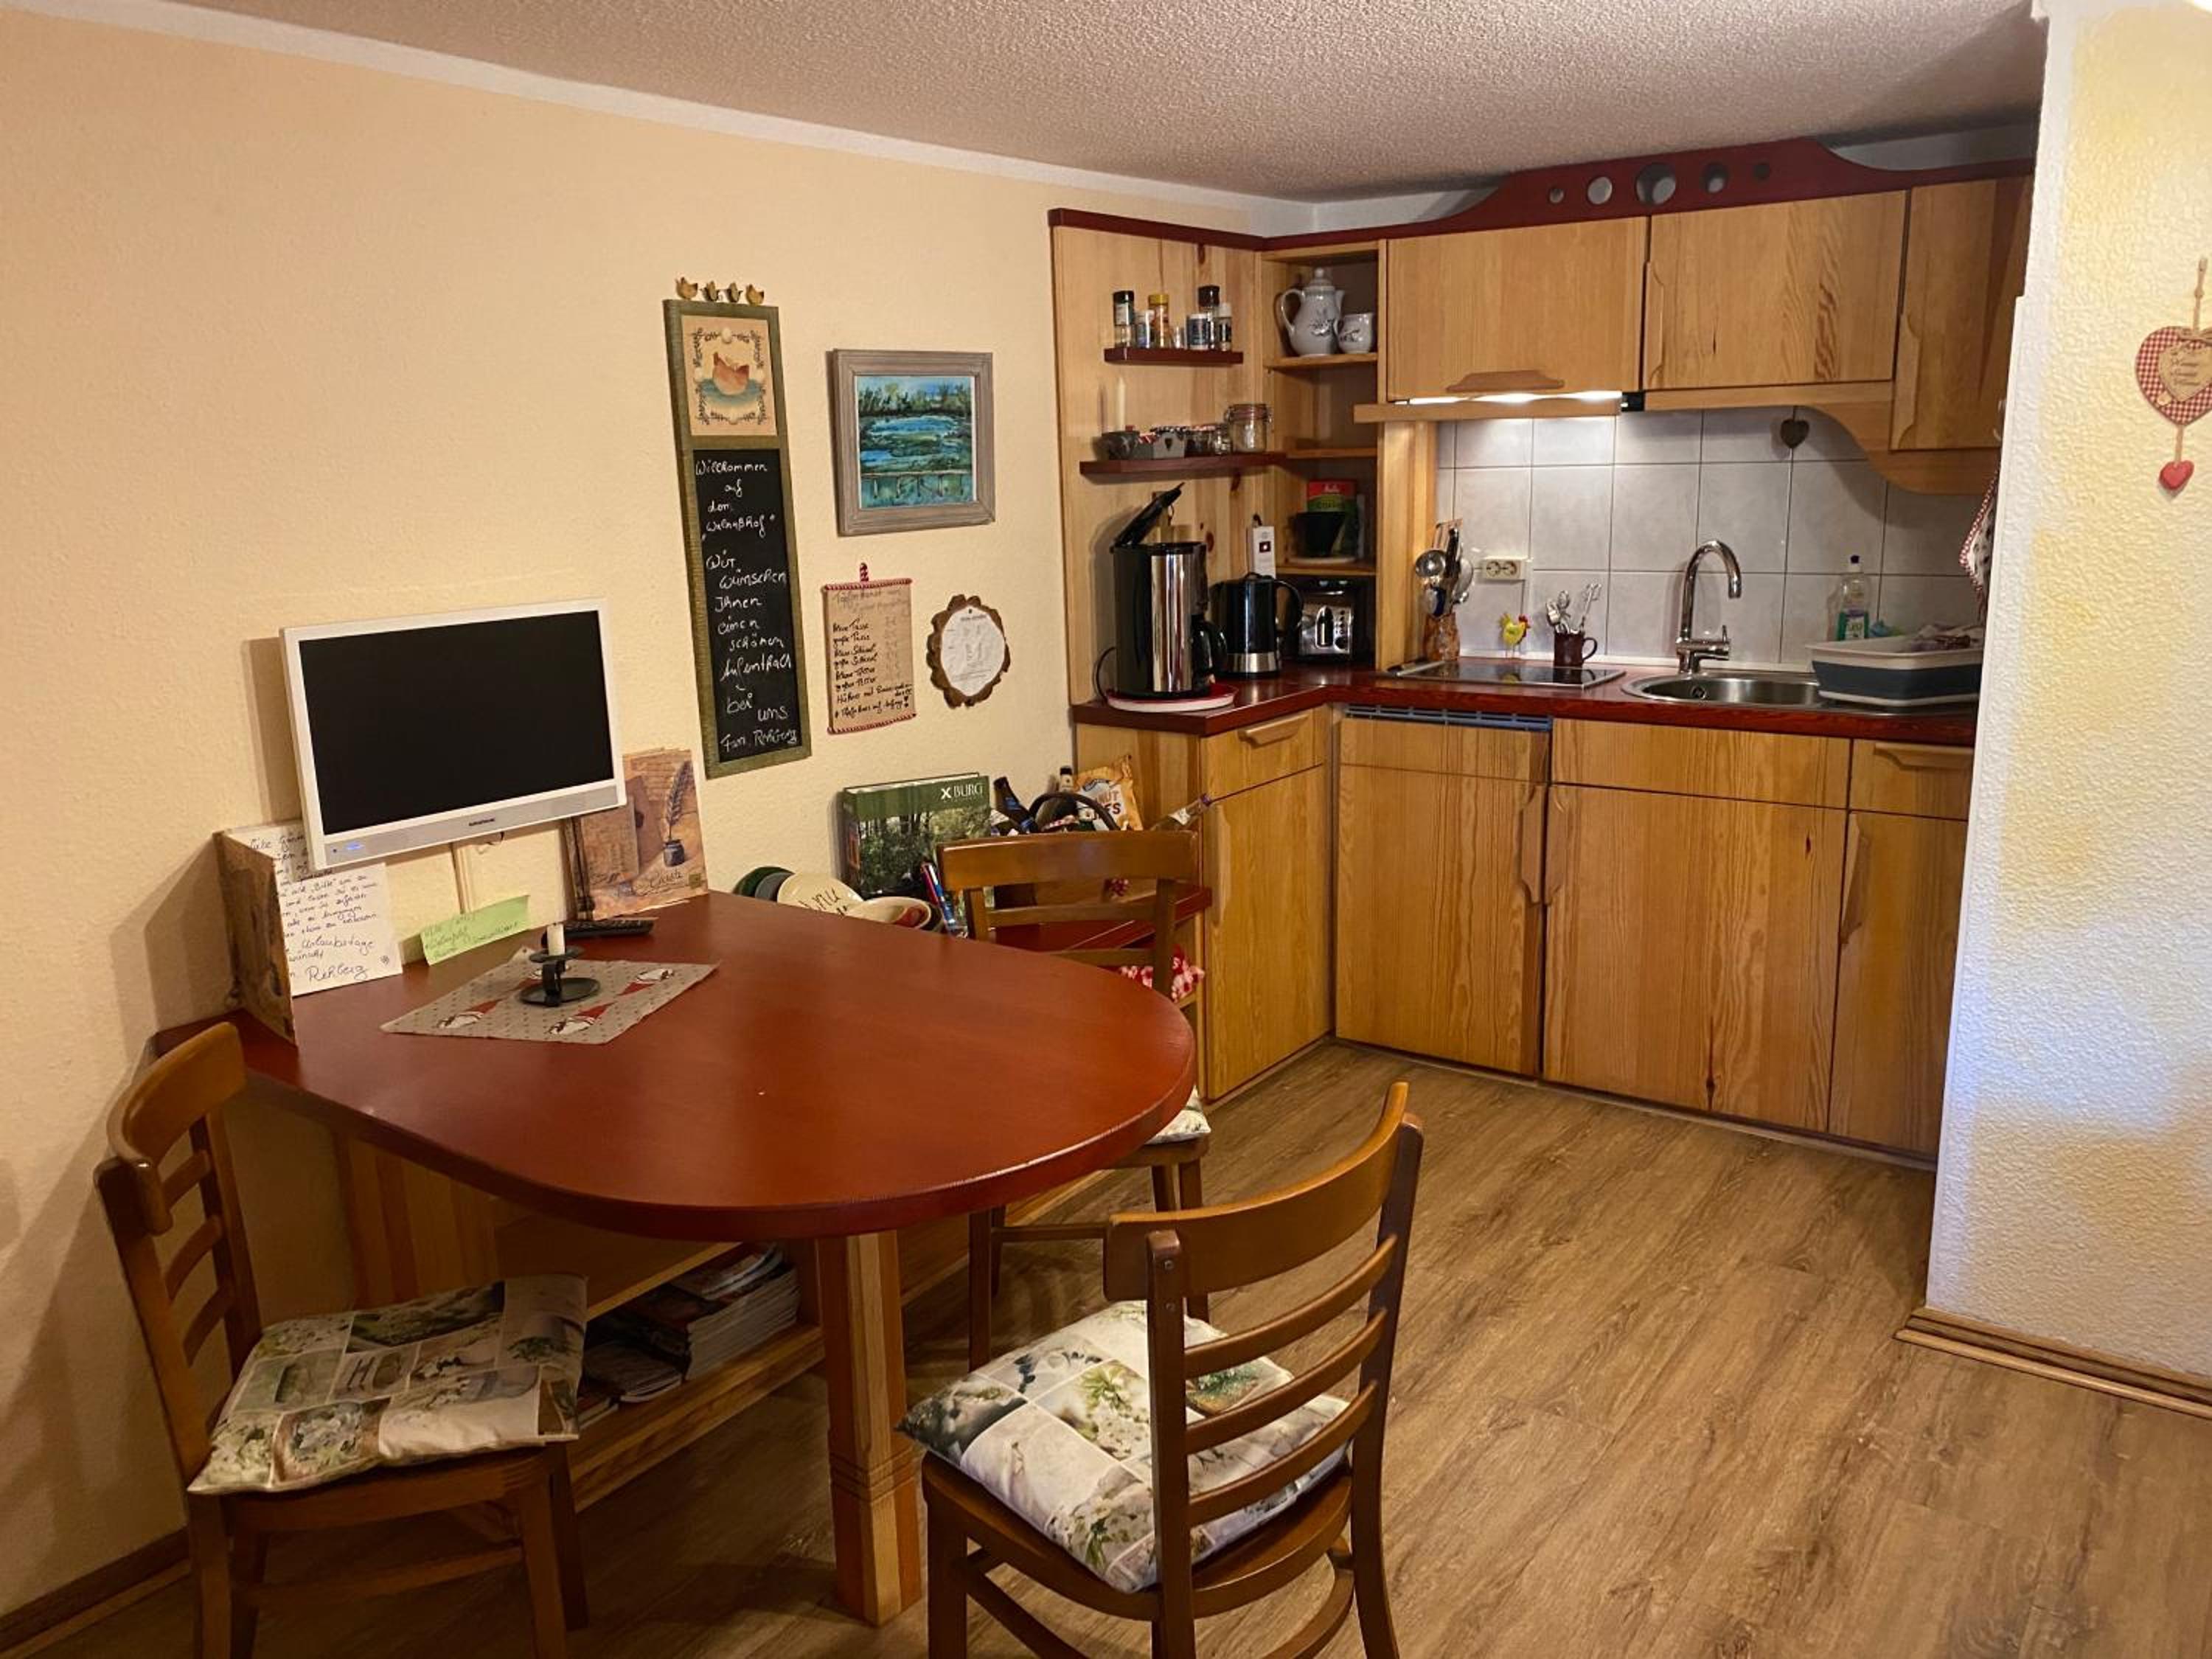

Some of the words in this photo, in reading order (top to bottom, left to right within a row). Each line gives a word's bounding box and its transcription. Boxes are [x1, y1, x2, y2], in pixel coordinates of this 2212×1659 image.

[695, 459, 768, 476] Willkommen
[724, 478, 742, 498] auf
[706, 549, 737, 570] Wir
[729, 632, 785, 653] schönen
[720, 653, 792, 686] Aufenthalt
[726, 692, 753, 714] bei
[757, 706, 788, 722] uns
[306, 962, 369, 981] Rehberg
